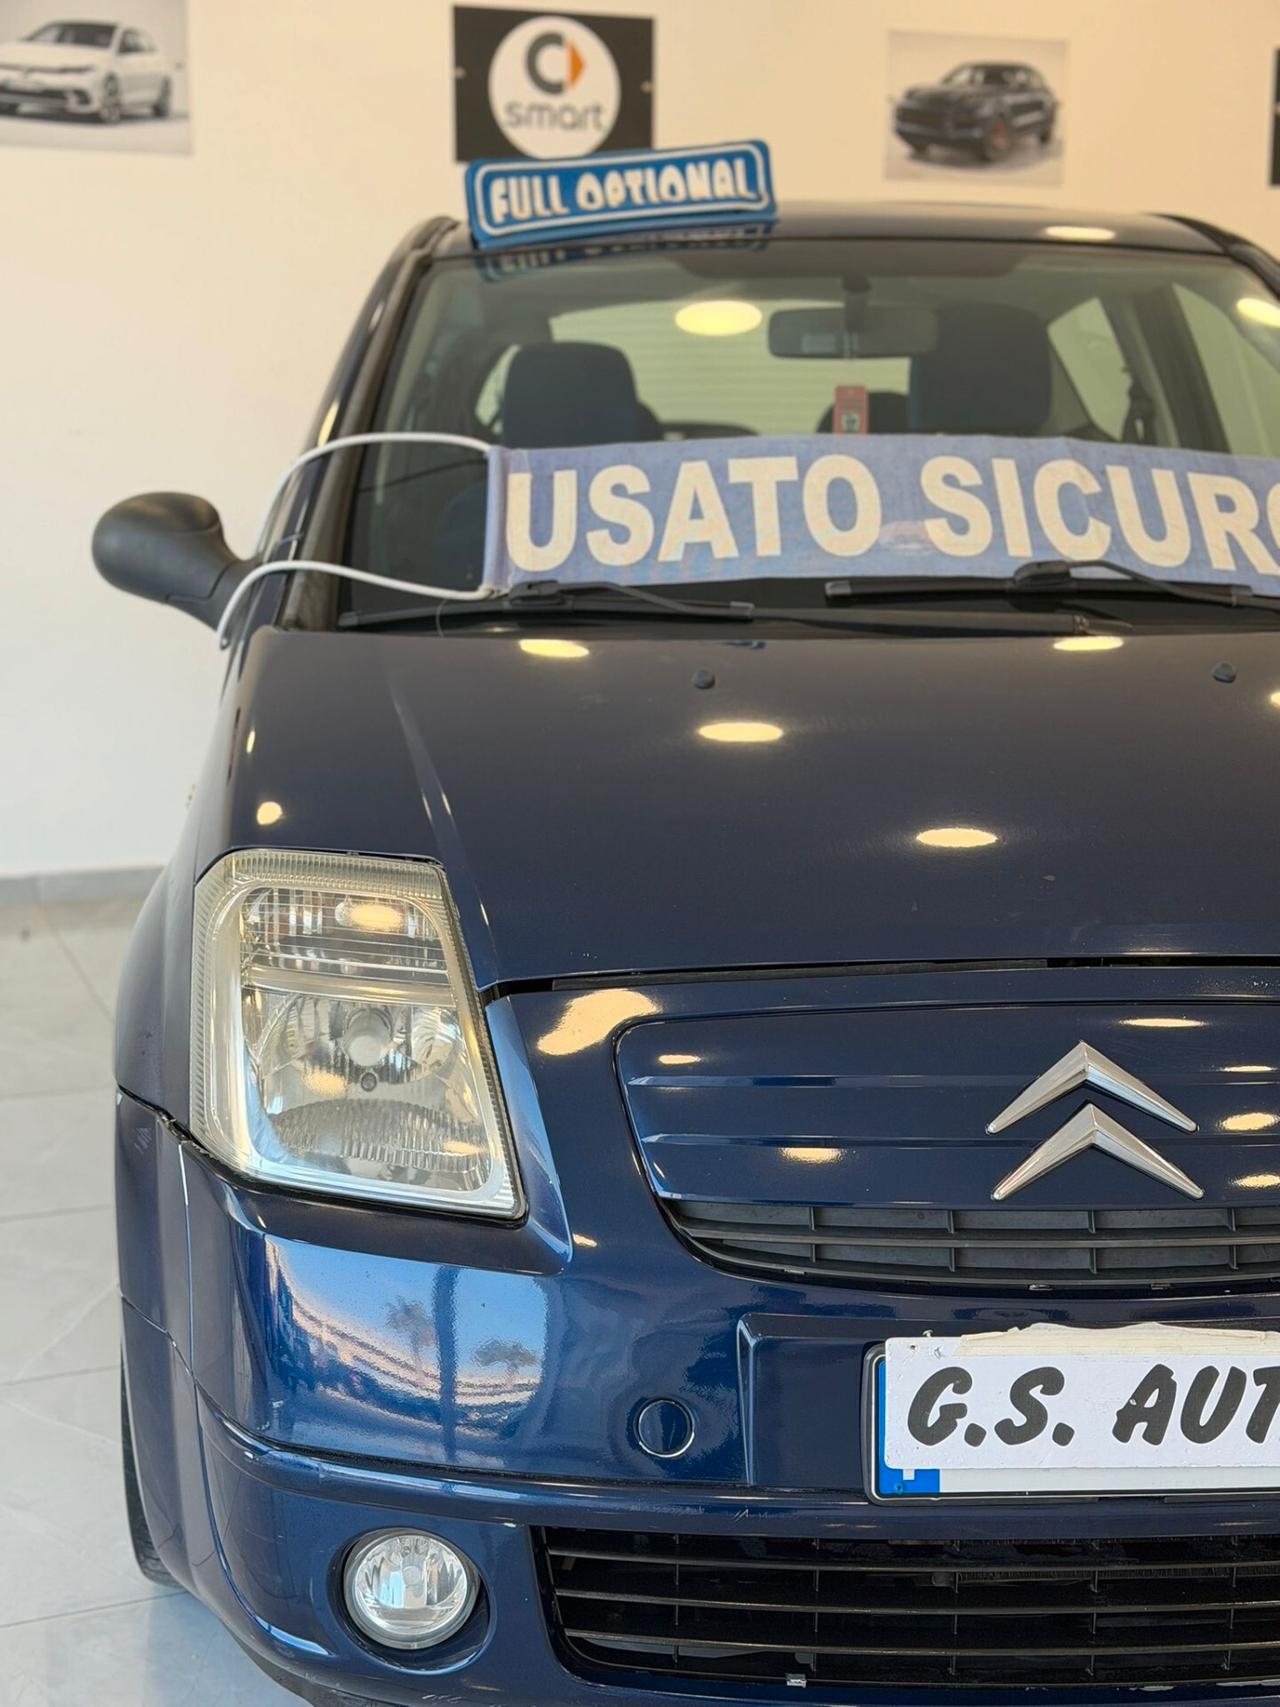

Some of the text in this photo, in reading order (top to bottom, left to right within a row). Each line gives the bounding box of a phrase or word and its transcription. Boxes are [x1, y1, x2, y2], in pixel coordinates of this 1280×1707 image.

[503, 101, 606, 132] smart
[489, 157, 757, 225] FULL OPTIONAL
[505, 453, 1280, 576] USATO SICUR
[907, 1366, 1075, 1448] G.S.
